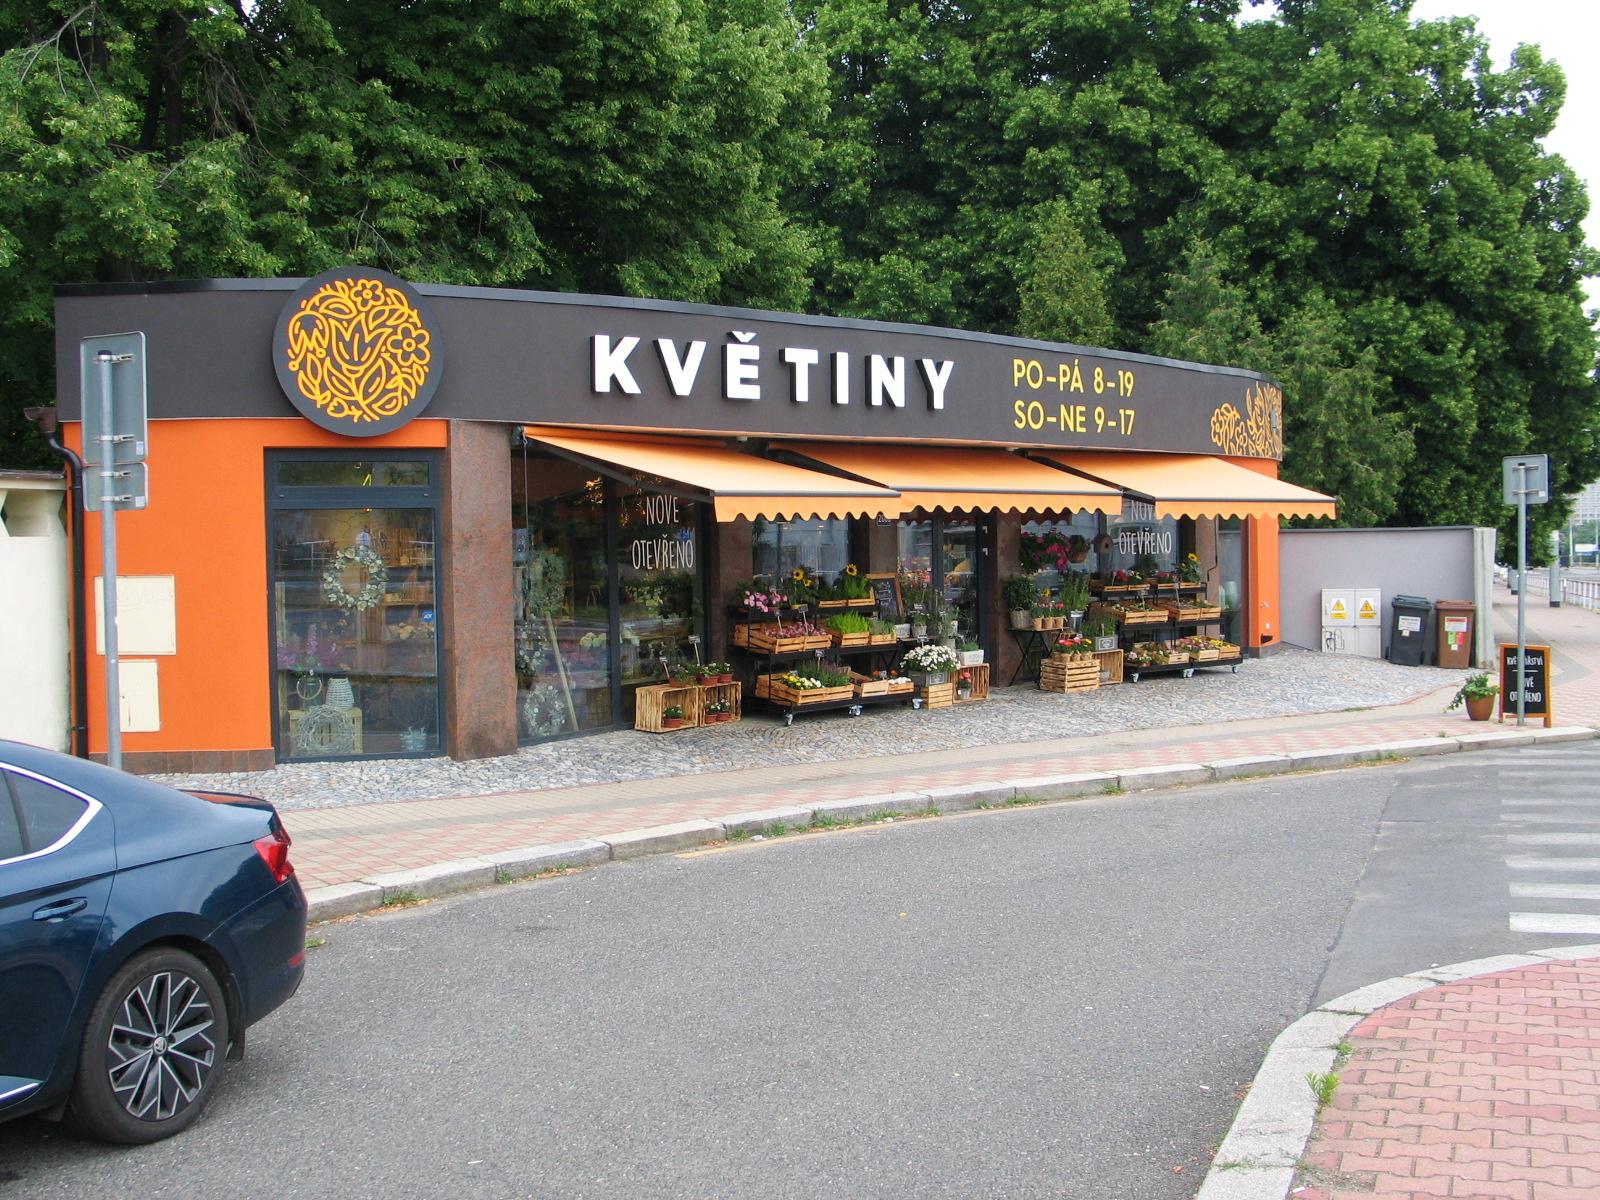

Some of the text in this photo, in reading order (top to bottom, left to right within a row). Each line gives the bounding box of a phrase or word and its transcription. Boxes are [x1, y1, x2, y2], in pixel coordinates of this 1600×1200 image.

[591, 330, 954, 410] KVĚTINY
[1013, 358, 1134, 398] PO-PÁ 8-19
[1013, 400, 1135, 436] SO-NE 9-17
[632, 533, 694, 571] OTEVŘENO
[1119, 528, 1172, 555] OTEVŘENO
